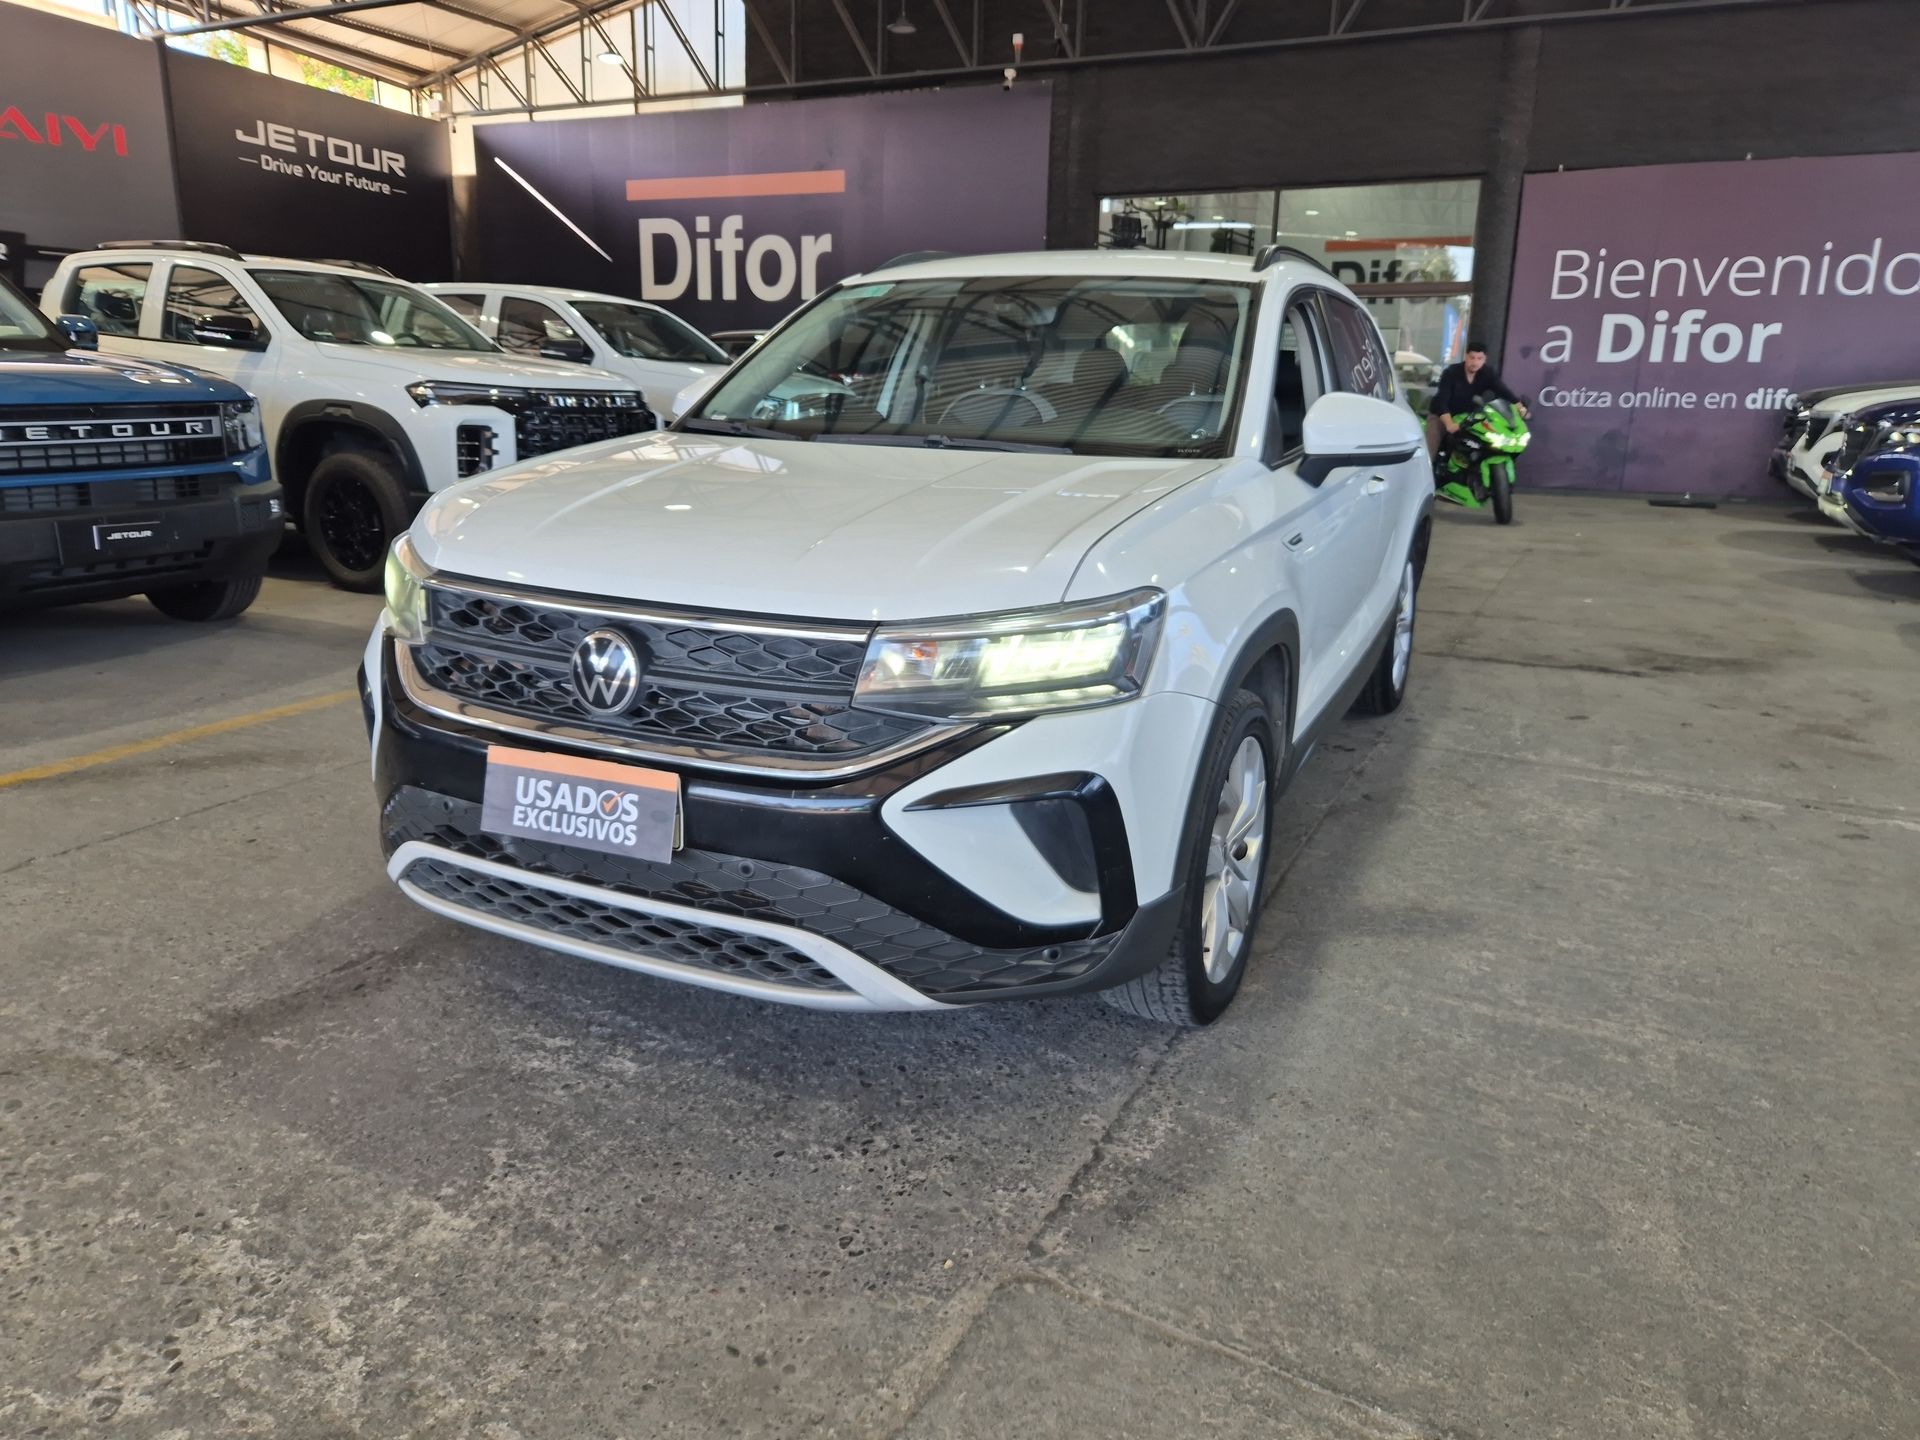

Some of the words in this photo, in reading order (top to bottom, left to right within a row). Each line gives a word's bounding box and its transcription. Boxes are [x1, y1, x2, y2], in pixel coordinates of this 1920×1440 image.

[235, 120, 406, 178] JETOUR
[260, 154, 303, 177] Drive
[305, 163, 342, 185] Your
[345, 172, 391, 195] Future
[638, 214, 833, 302] Difor
[1539, 323, 1573, 363] a
[1596, 308, 1782, 363] Difor
[1538, 386, 1612, 408] Cotiza
[1618, 387, 1697, 409] online
[1703, 391, 1737, 409] en
[0, 421, 203, 441] ETOUR
[106, 530, 154, 541] JETOUR
[515, 775, 640, 823] USADOS
[512, 804, 638, 847] EXCLUSIVOS
